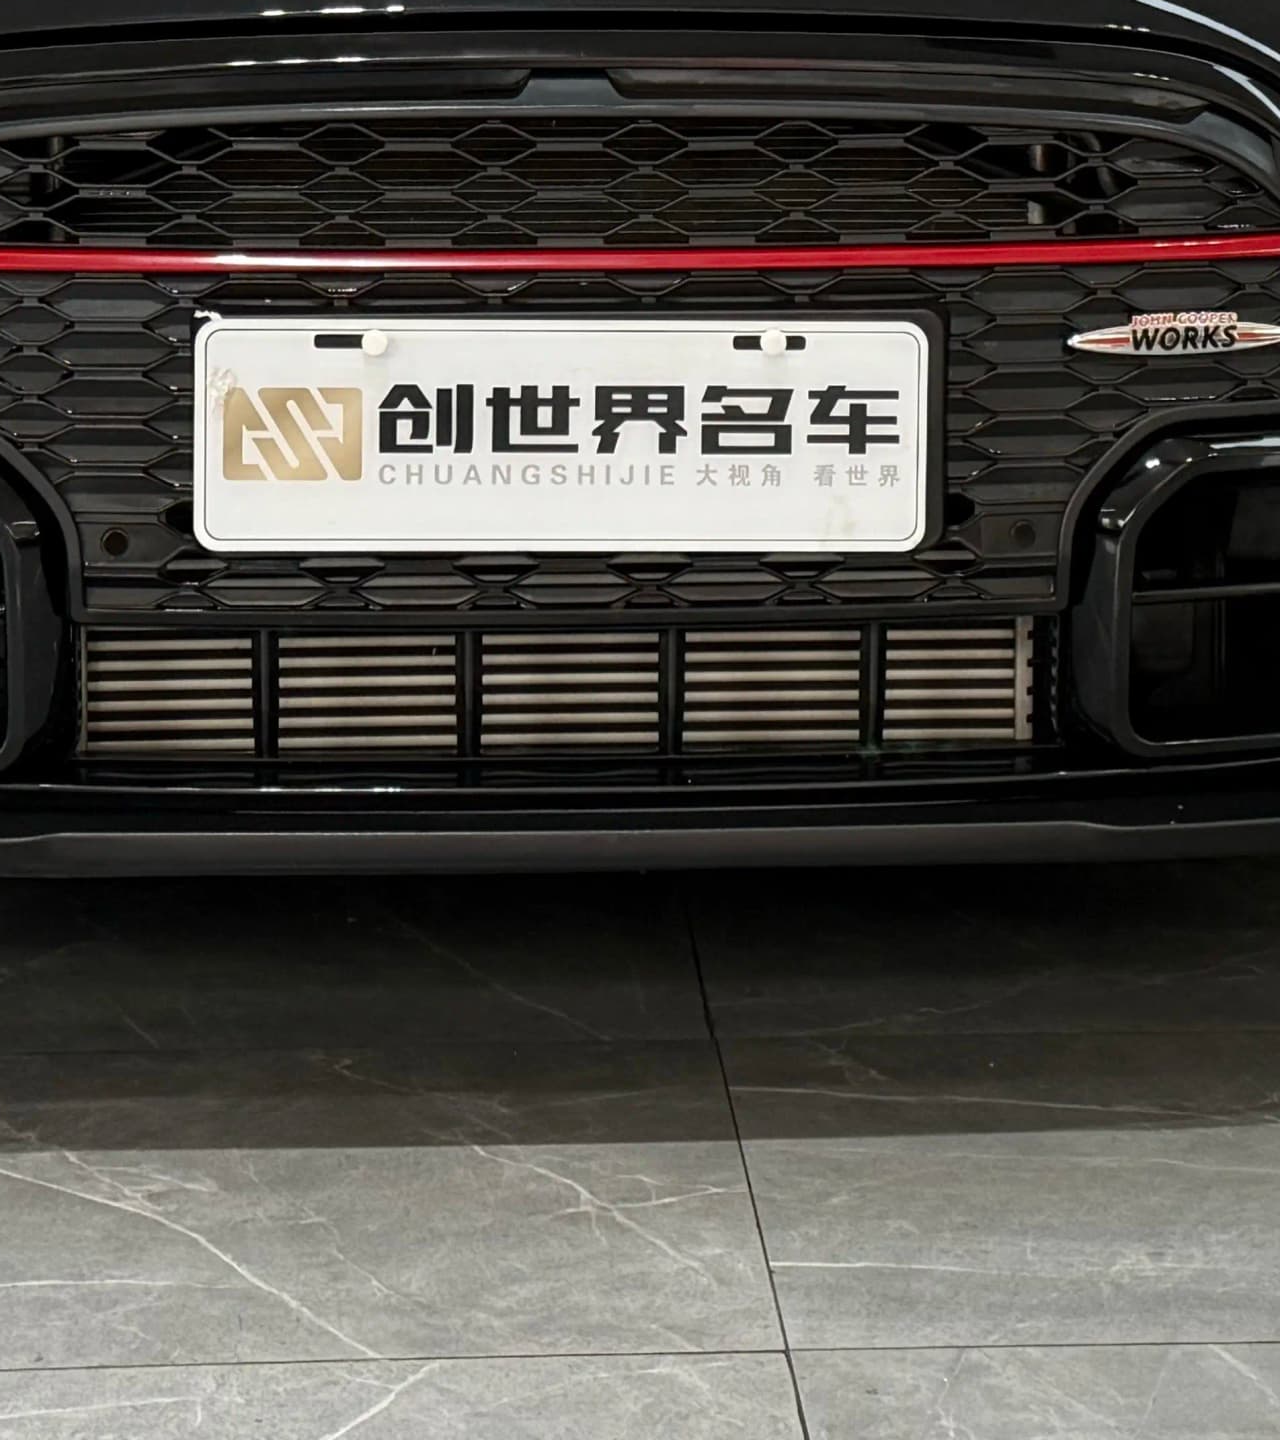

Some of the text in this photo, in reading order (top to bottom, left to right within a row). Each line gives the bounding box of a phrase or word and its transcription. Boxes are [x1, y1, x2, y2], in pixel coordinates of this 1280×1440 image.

[1131, 325, 1238, 351] WORKS
[378, 383, 901, 455] 创世界名车
[378, 463, 901, 487] CHUANGSHIJIE 大视角 看世界
